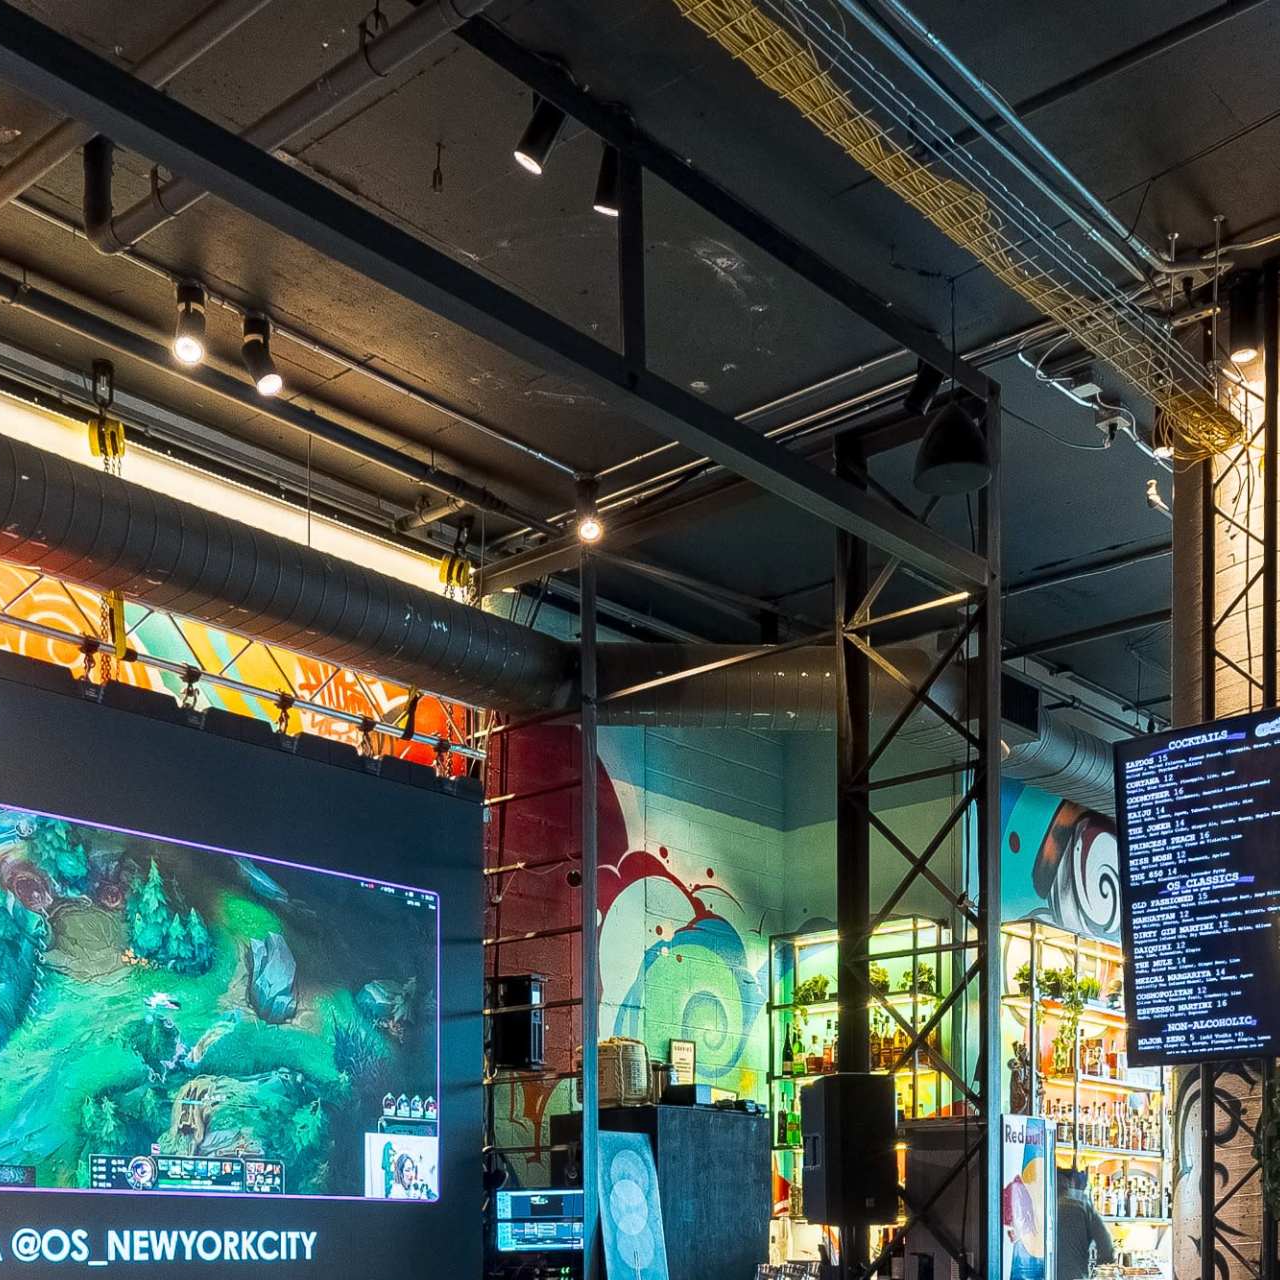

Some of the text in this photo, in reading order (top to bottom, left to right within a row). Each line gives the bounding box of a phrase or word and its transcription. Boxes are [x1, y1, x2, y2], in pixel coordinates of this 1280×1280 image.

[1168, 730, 1227, 750] COCKTAILS
[1125, 754, 1168, 769] ZAPDOS 15
[1126, 773, 1173, 789] CORTANA 12
[1126, 790, 1169, 804] GODMOTHER
[1174, 787, 1183, 795] 16
[1127, 806, 1164, 819] KAIJU 14
[1128, 819, 1184, 835] THE JOKER 14
[1129, 839, 1166, 851] PRINCESS
[1170, 834, 1195, 844] PEACH
[1199, 831, 1209, 839] 16
[1129, 857, 1149, 866] MISH
[1152, 853, 1172, 862] MOSH
[1176, 850, 1185, 858] 12
[1130, 872, 1145, 881] THE
[1167, 867, 1177, 875] 14
[1166, 881, 1180, 891] OS
[1185, 872, 1238, 887] CLASSICS
[1131, 892, 1208, 909] OLD FASHIONED 15
[1132, 912, 1175, 924] MANHATTAN
[1179, 910, 1189, 918] 12
[1133, 930, 1157, 939] DIRTY
[1160, 927, 1176, 936] GIN
[1179, 922, 1213, 933] MARTINI
[1219, 920, 1228, 928] 12
[1134, 943, 1171, 954] DAIQUIRI
[1176, 941, 1185, 949] 12
[1134, 956, 1185, 969] THE MULE 14
[1135, 968, 1225, 984] MEZCAL MARGARITA 14
[1136, 986, 1206, 1000] COSMOPOLITAN 12
[1136, 999, 1227, 1015] ESPRESSO MARTINI 16
[1167, 1016, 1252, 1031] NON-ALCOHOLIC
[1137, 1037, 1162, 1045] MAJOR
[1005, 1124, 1024, 1144] Red
[12, 1228, 318, 1266] @OS_NEWYORKCITY
